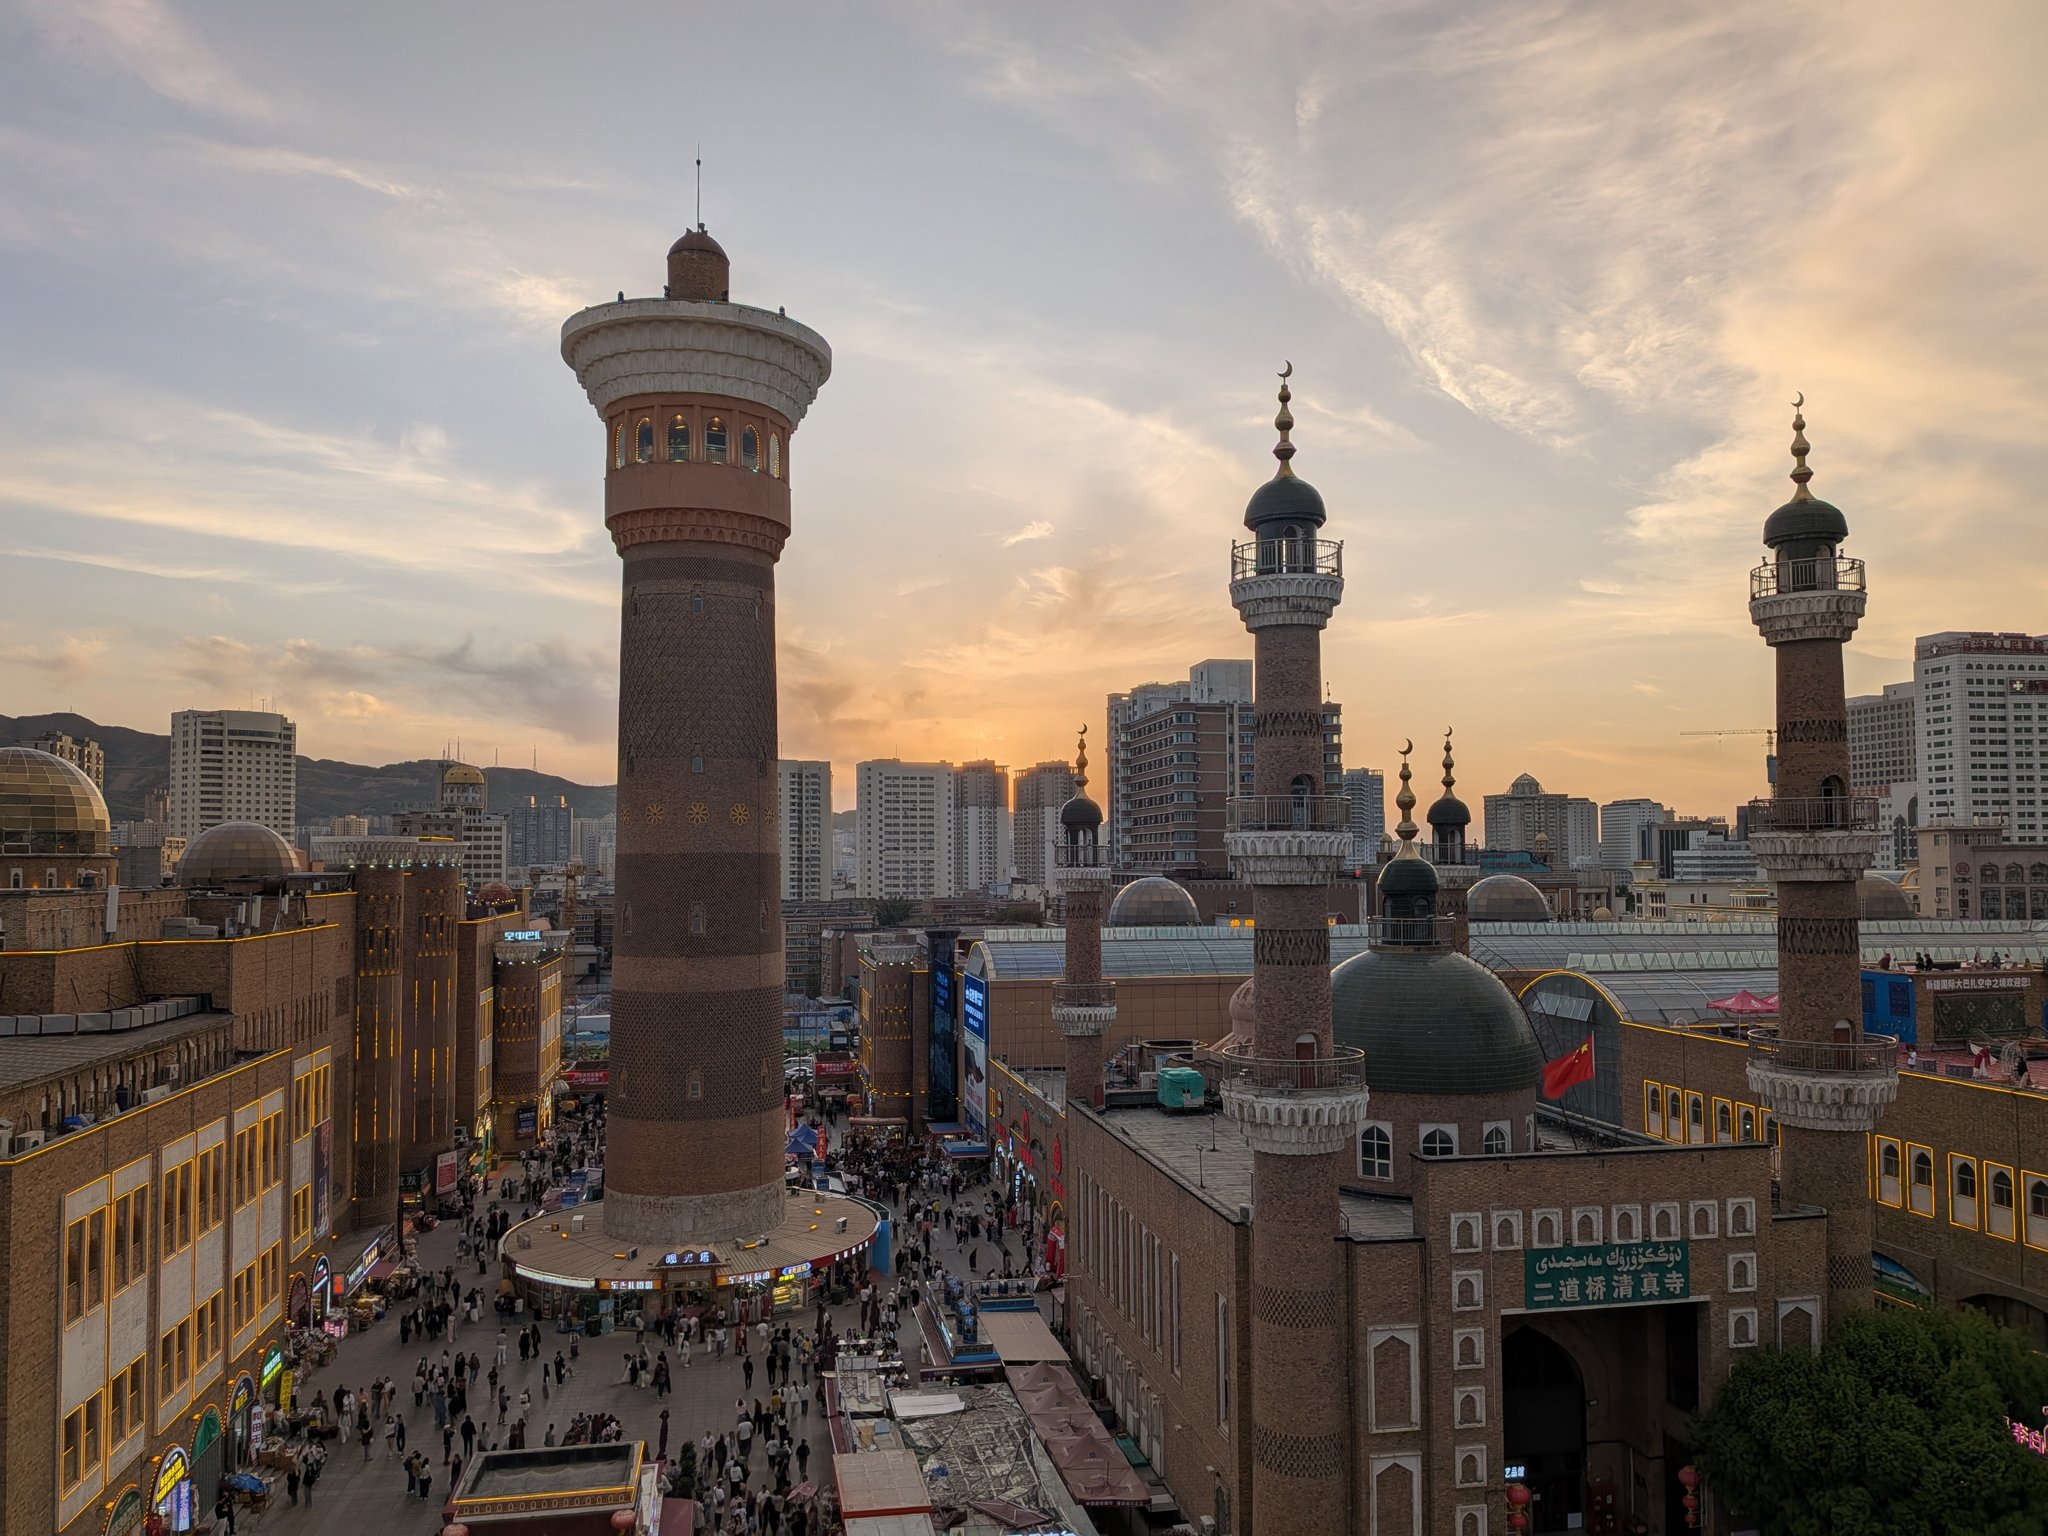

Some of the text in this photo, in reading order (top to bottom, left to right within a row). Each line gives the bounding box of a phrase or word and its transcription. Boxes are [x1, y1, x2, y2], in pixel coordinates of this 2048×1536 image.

[1533, 1270, 1685, 1303] 二道桥清真寺
